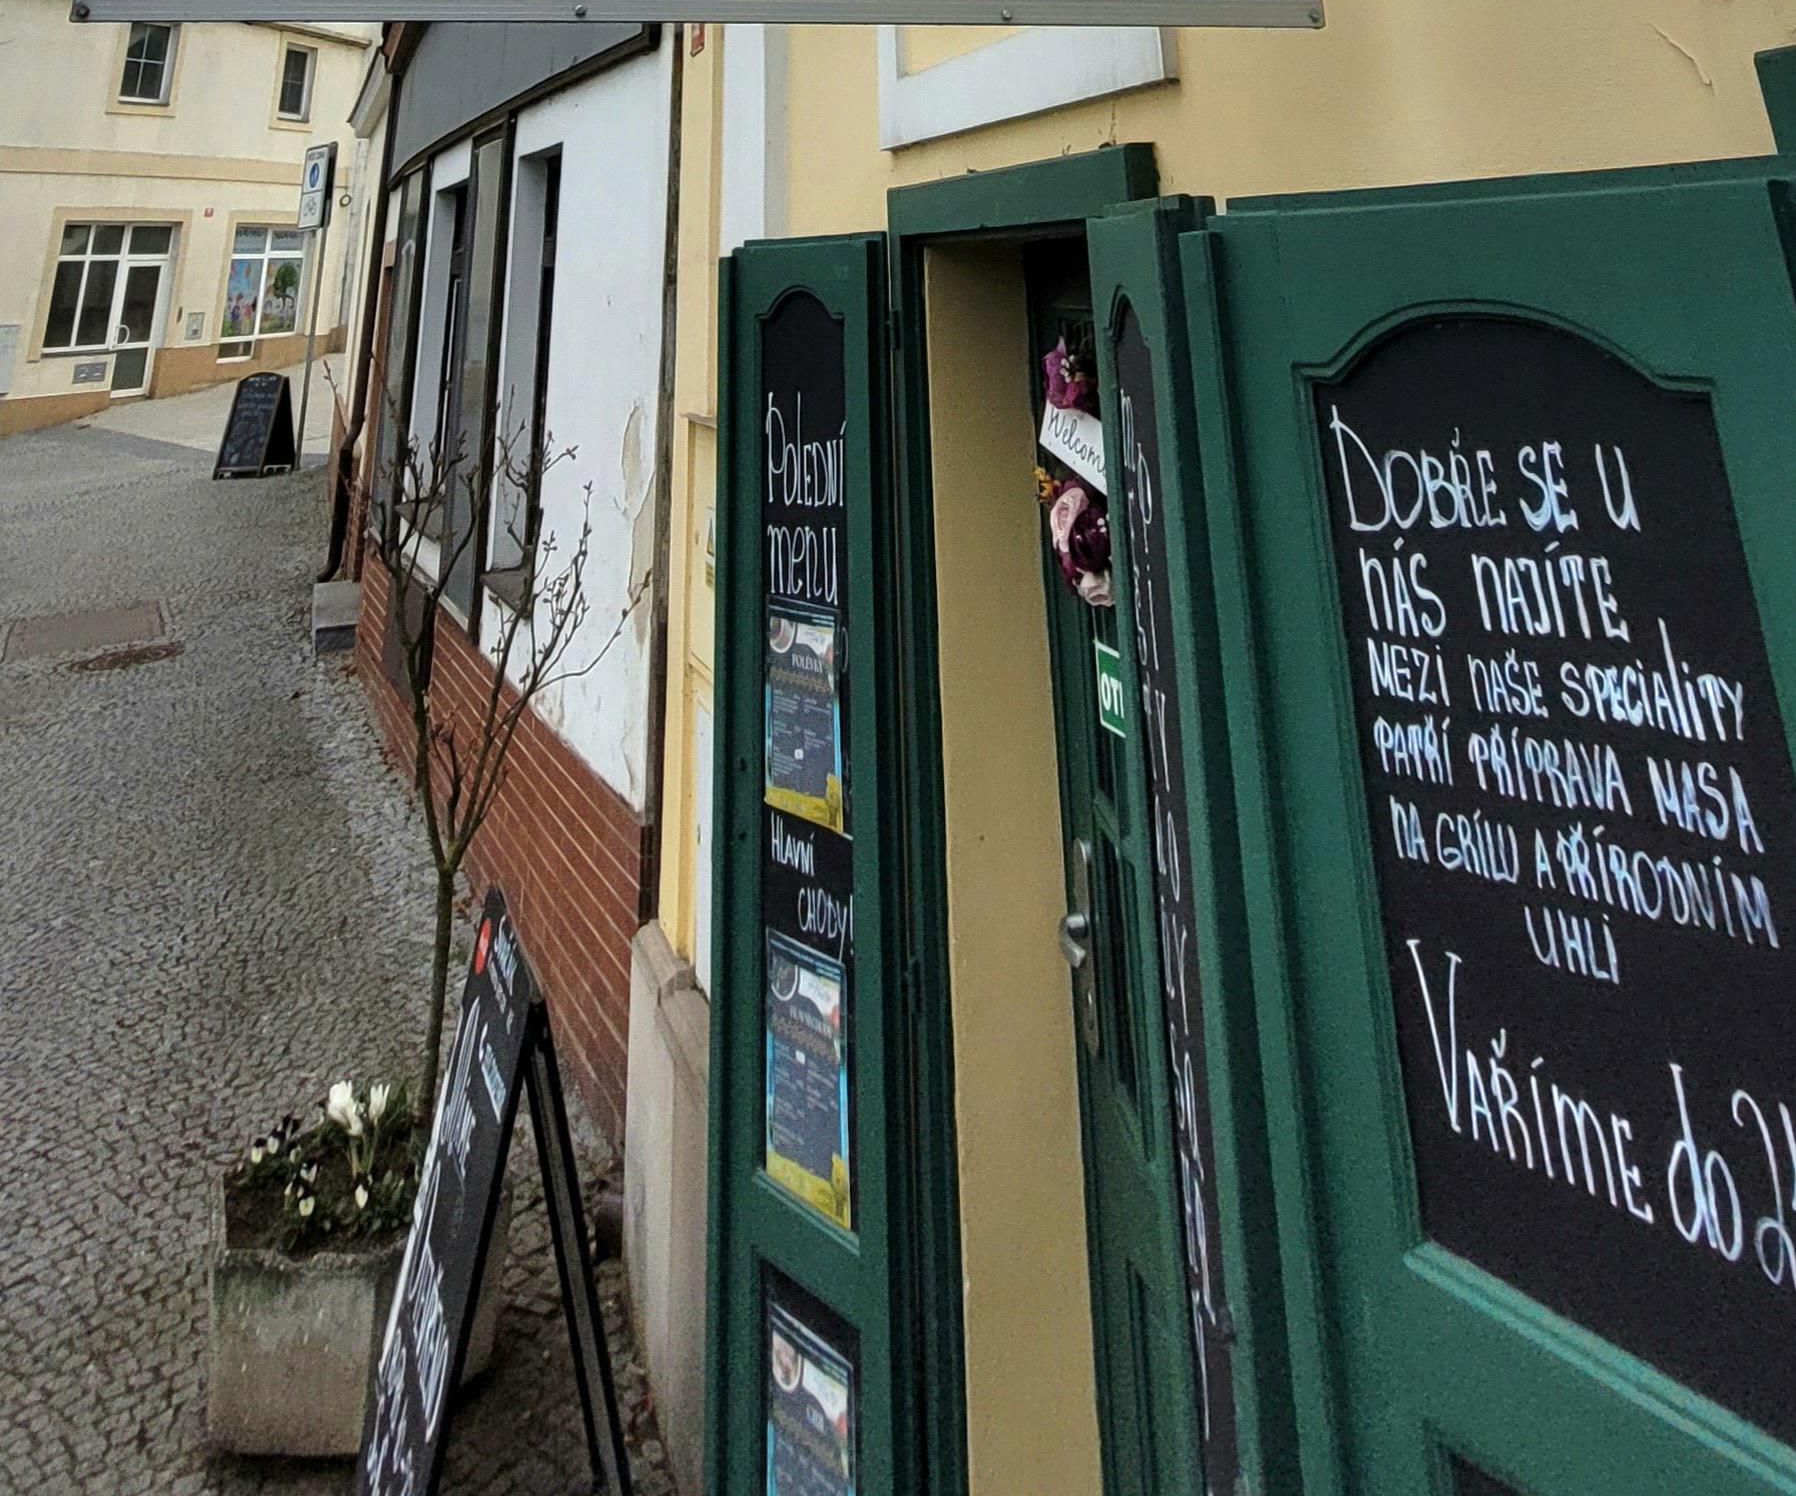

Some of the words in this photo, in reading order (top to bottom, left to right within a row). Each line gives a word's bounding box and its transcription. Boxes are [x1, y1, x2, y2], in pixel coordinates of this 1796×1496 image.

[1048, 406, 1105, 478] Welcom
[1518, 440, 1579, 534] SE
[1594, 443, 1642, 533] U
[771, 811, 815, 877] HLAVNÍ
[1534, 827, 1557, 890] A
